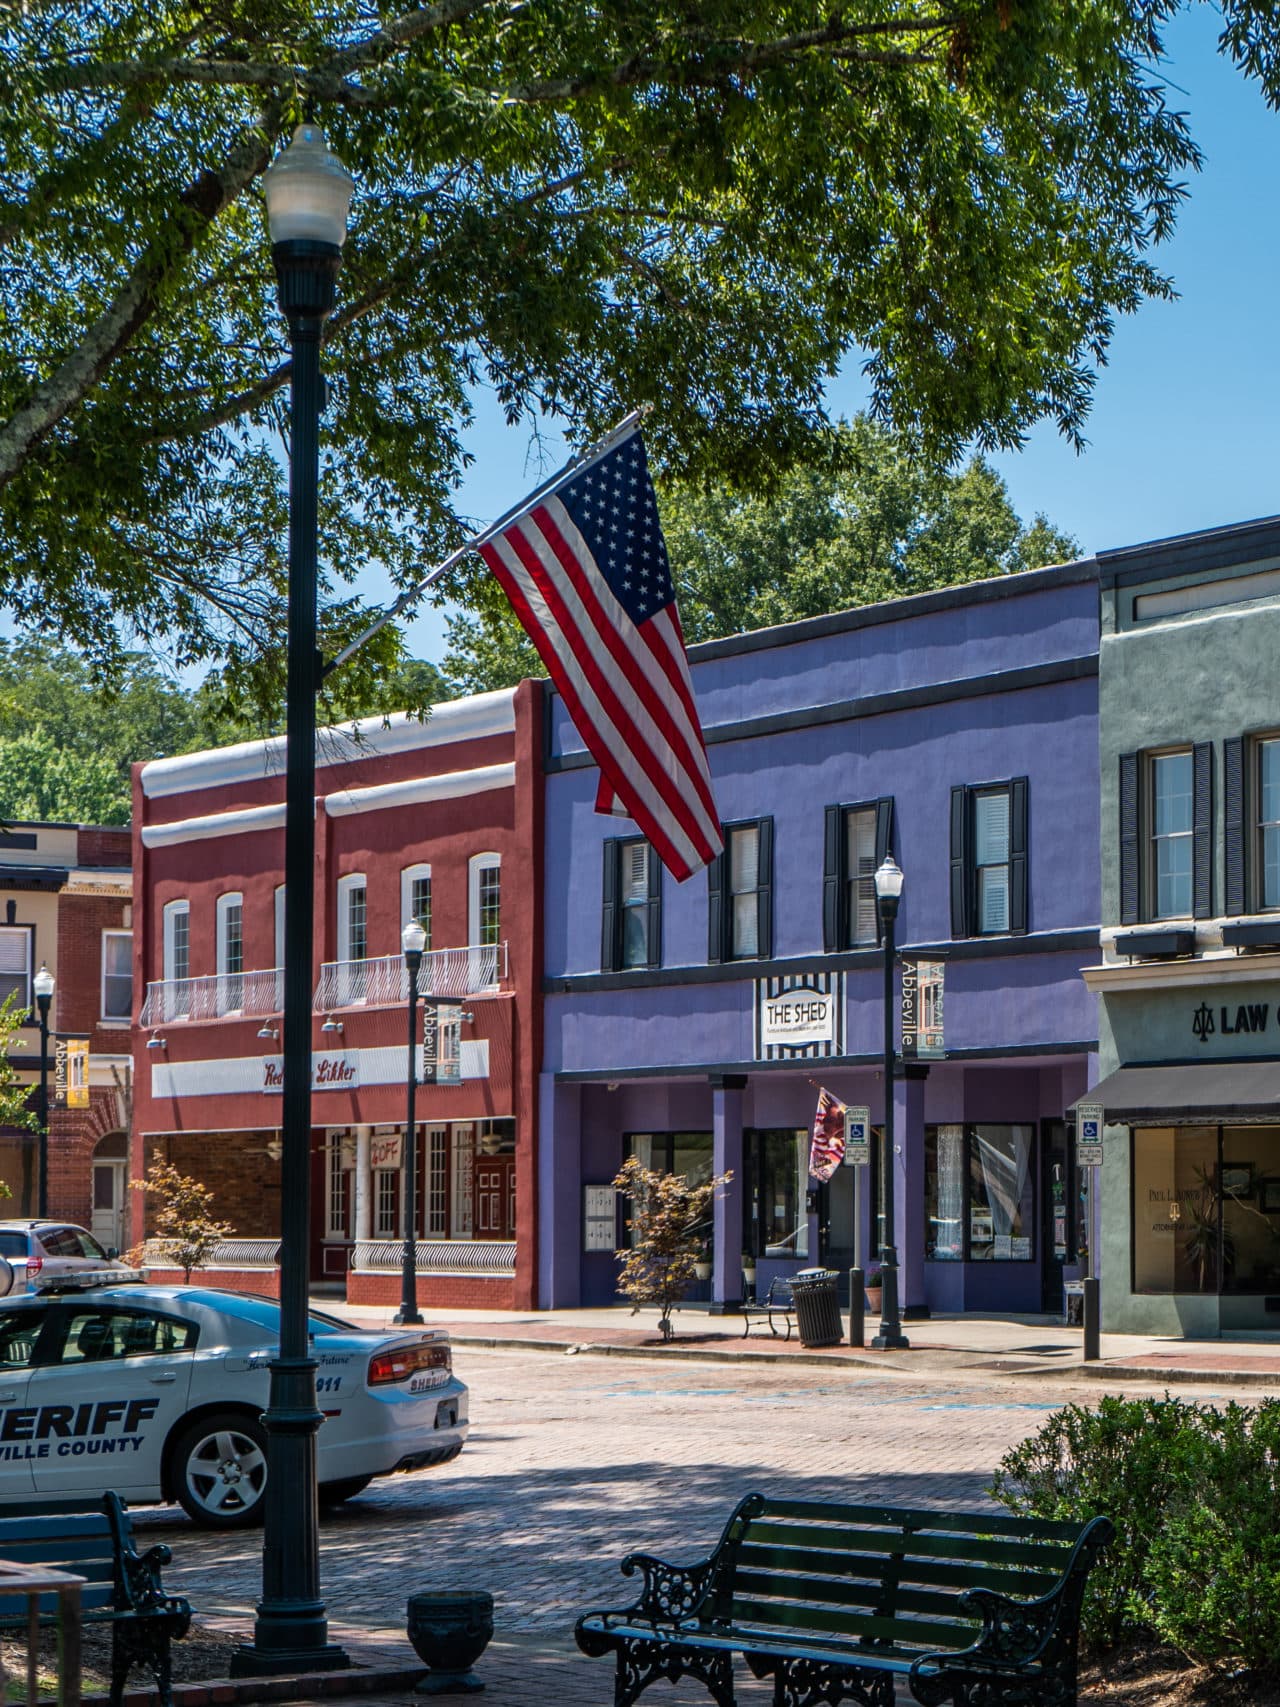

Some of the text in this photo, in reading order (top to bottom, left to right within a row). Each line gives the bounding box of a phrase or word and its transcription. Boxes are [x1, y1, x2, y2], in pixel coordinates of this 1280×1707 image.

[767, 1001, 827, 1025] THE SHED
[902, 961, 917, 1046] Abbeville
[1221, 1004, 1269, 1034] LAW
[424, 1004, 437, 1075] Abbeville
[55, 1040, 67, 1100] Abbeville
[0, 1398, 160, 1442] ERIFF
[57, 1436, 144, 1457] COUNTY
